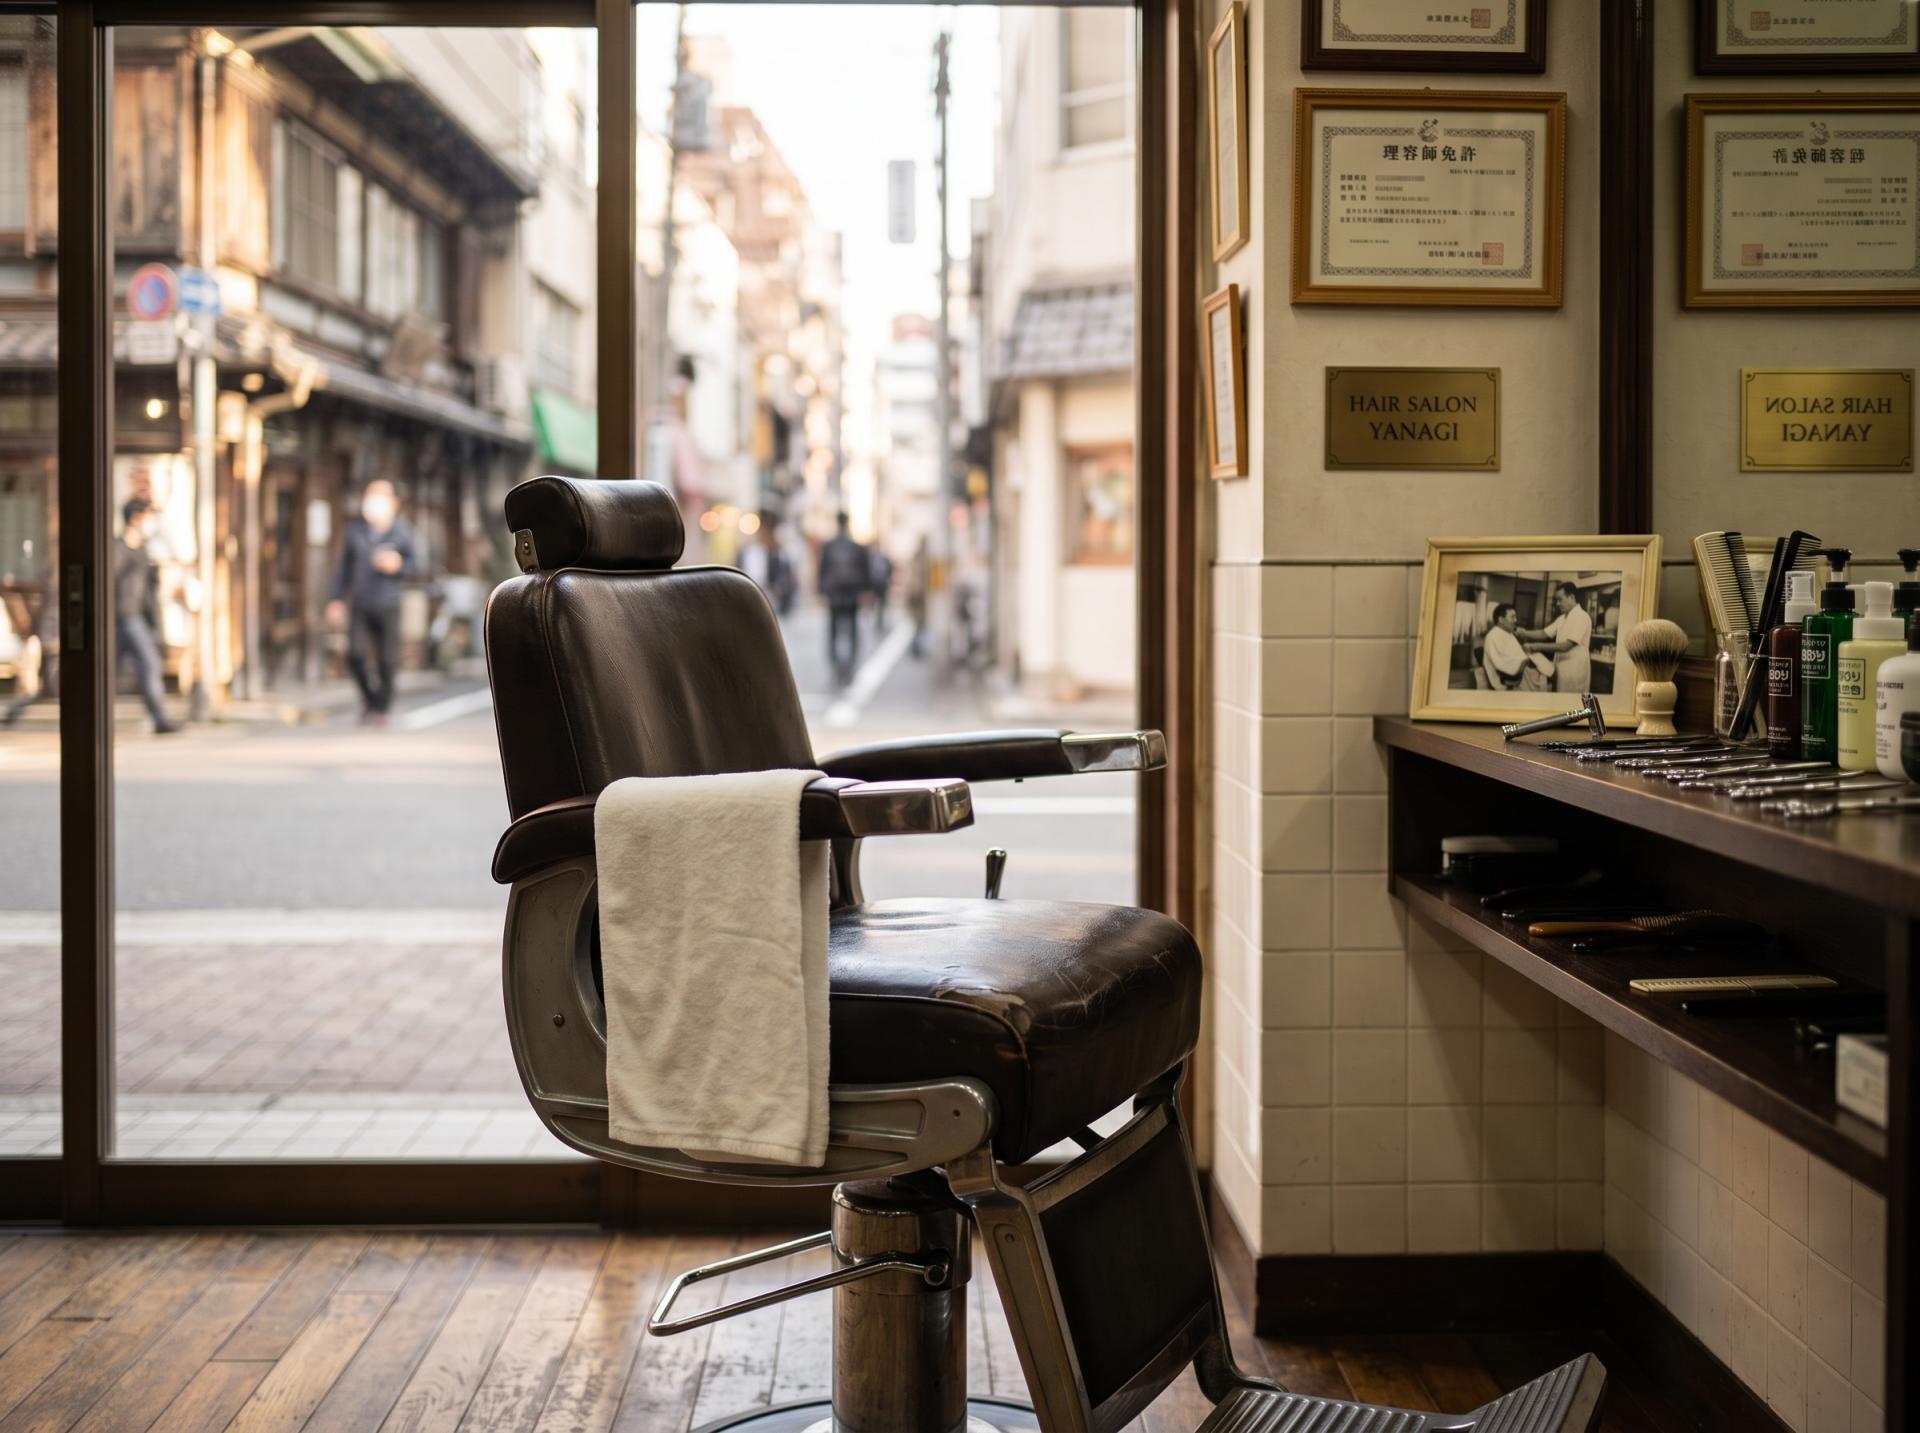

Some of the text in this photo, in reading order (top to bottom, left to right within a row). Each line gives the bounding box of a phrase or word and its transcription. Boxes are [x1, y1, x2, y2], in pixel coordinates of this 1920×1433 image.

[1382, 144, 1477, 163] 理容師免許
[1349, 395, 1477, 413] HAIR SALON
[1369, 421, 1459, 441] YANAGI
